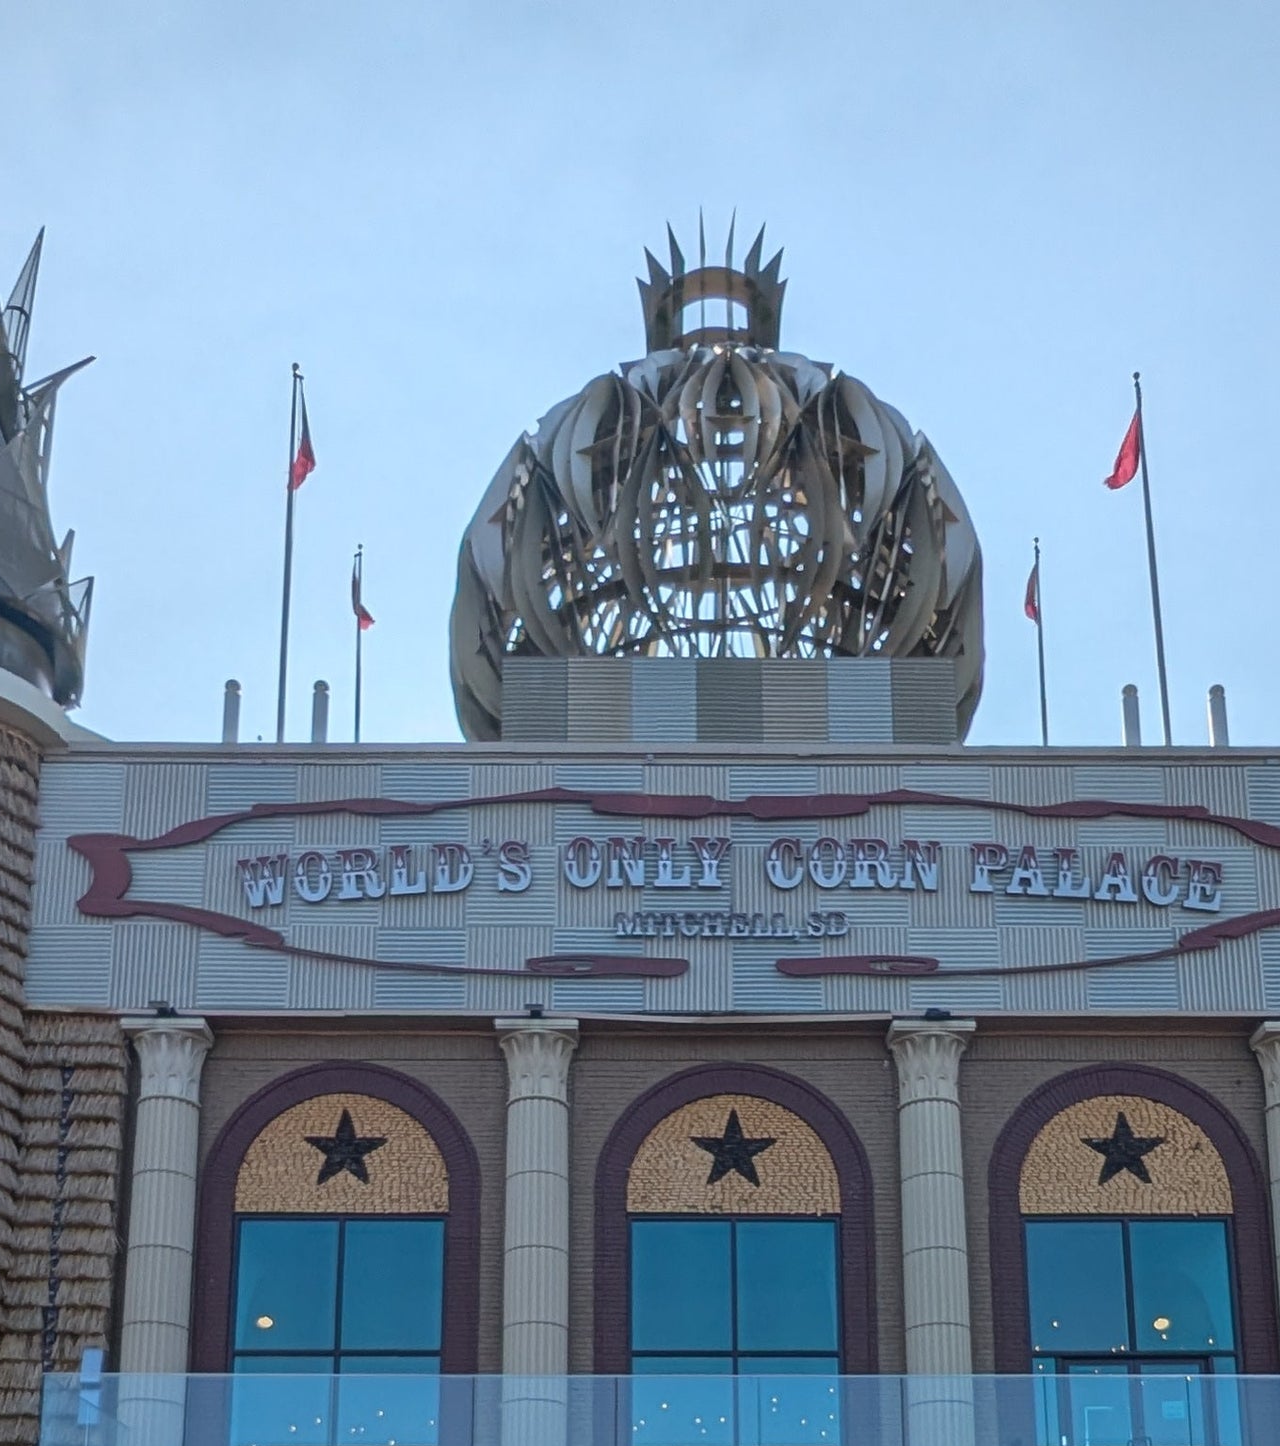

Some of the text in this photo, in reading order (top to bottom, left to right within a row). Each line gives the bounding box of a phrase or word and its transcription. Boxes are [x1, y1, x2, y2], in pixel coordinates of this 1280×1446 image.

[236, 836, 1223, 913] WORLD'S ONLY CORN PALACE
[614, 911, 850, 941] MITCHELL, SD
